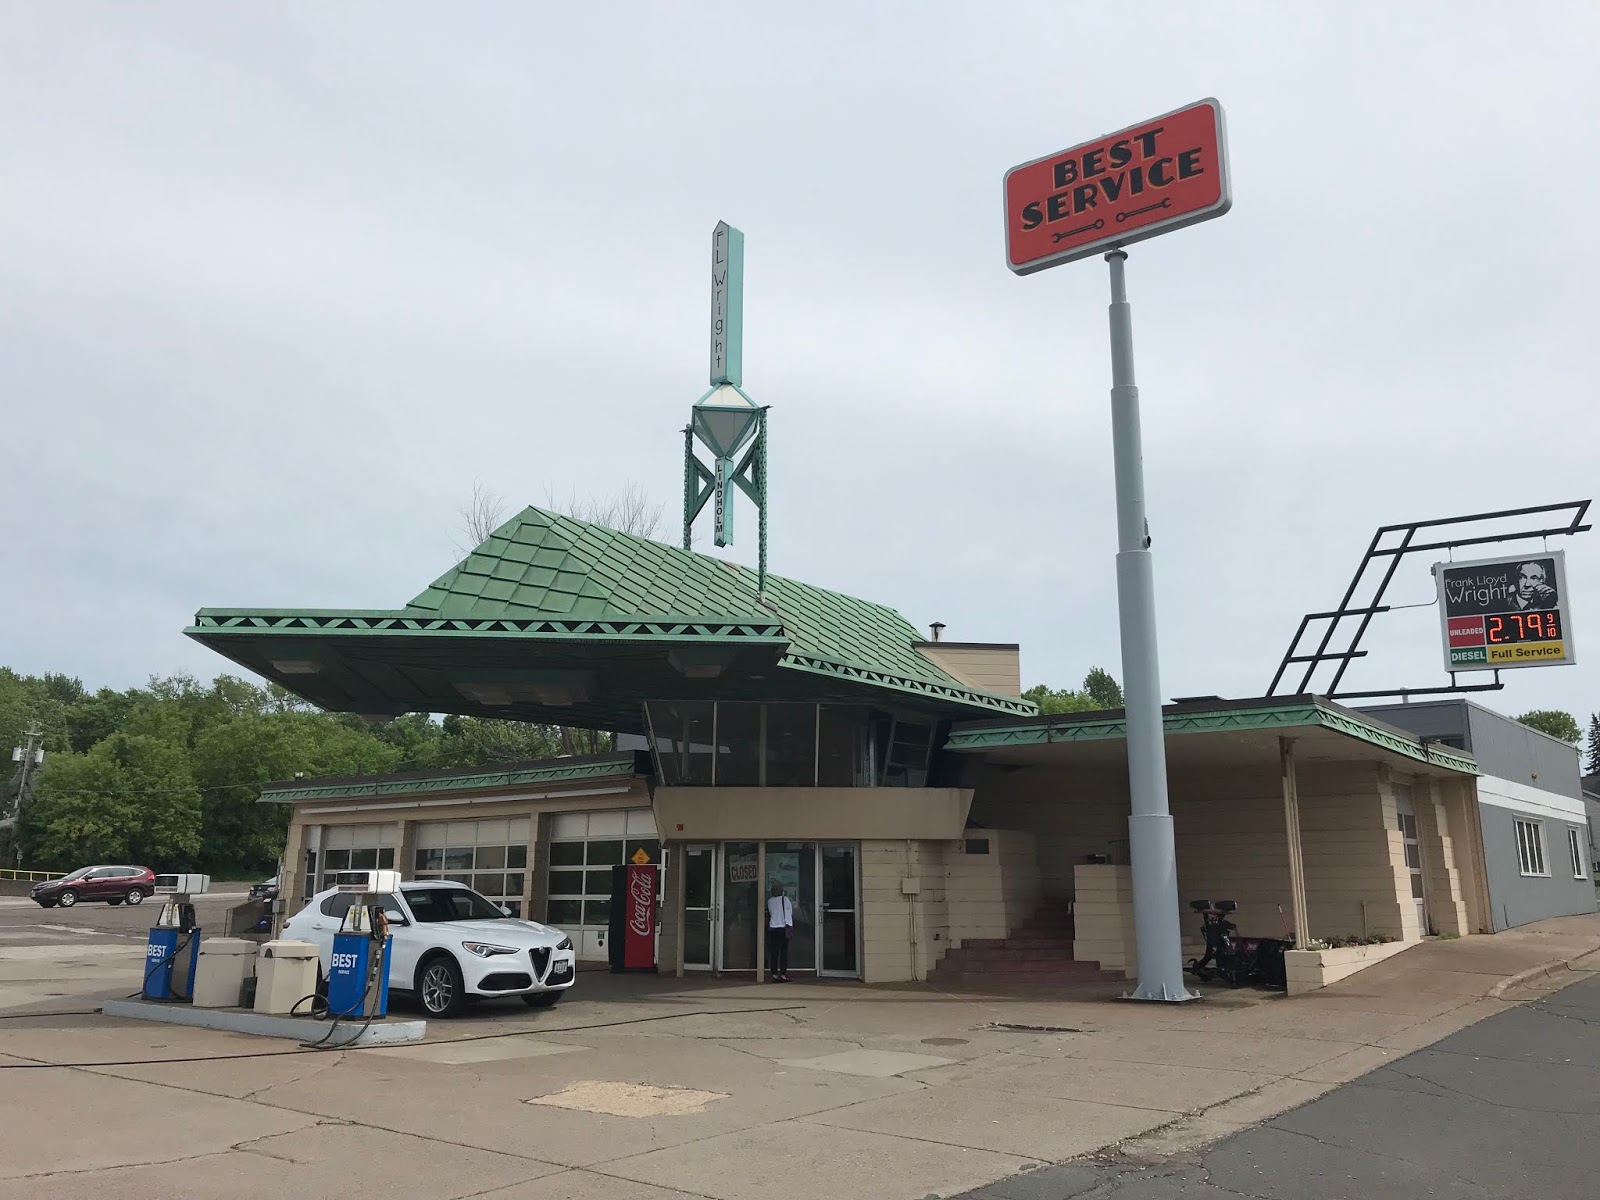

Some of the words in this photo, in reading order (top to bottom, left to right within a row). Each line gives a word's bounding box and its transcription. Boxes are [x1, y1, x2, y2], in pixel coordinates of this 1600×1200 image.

[1052, 127, 1164, 191] BEST
[1020, 147, 1205, 232] SERVICE
[714, 270, 726, 368] Wright
[1445, 577, 1474, 588] Frank
[1477, 573, 1507, 587] Lloyd
[1446, 583, 1508, 606] Wright
[1450, 627, 1484, 637] UNLEADED
[1489, 614, 1543, 642] 2.79
[1451, 651, 1486, 661] DIESEL
[1491, 649, 1512, 659] Full
[1516, 647, 1561, 657] Service
[731, 865, 757, 880] CLOSED
[148, 944, 167, 958] BEST
[331, 953, 358, 968] BEST
